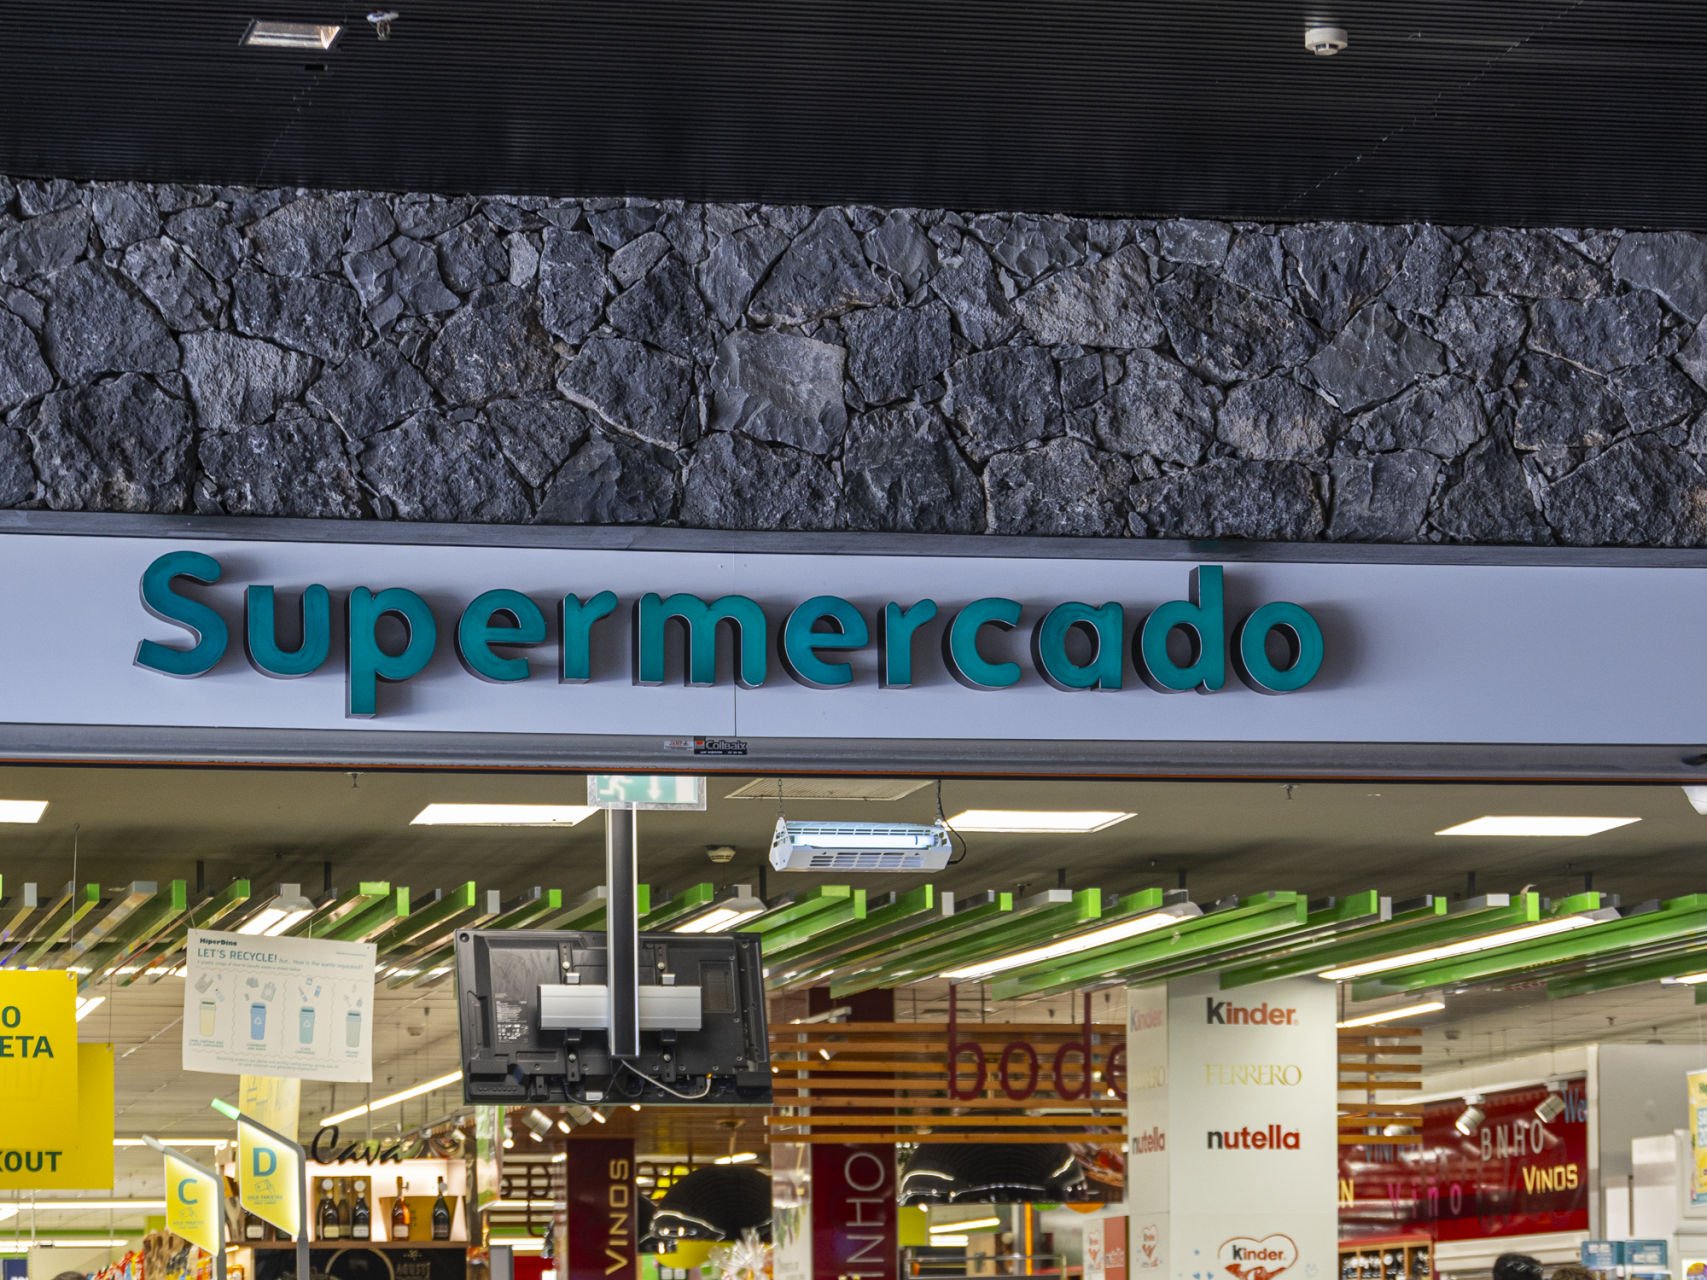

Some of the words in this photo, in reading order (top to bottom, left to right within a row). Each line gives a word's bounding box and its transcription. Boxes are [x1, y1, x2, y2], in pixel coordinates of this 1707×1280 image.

[133, 551, 1325, 718] Supermercado
[197, 948, 226, 959] LET'S
[230, 950, 277, 963] RECYCLE!
[200, 937, 237, 946] HiperDino
[1205, 1064, 1302, 1087] FERRERO
[311, 1125, 400, 1167] Cava
[1132, 1126, 1166, 1155] nutella
[1207, 1125, 1300, 1150] nutella
[253, 1147, 277, 1177] D
[178, 1178, 198, 1205] C
[605, 1159, 629, 1275] VINOS
